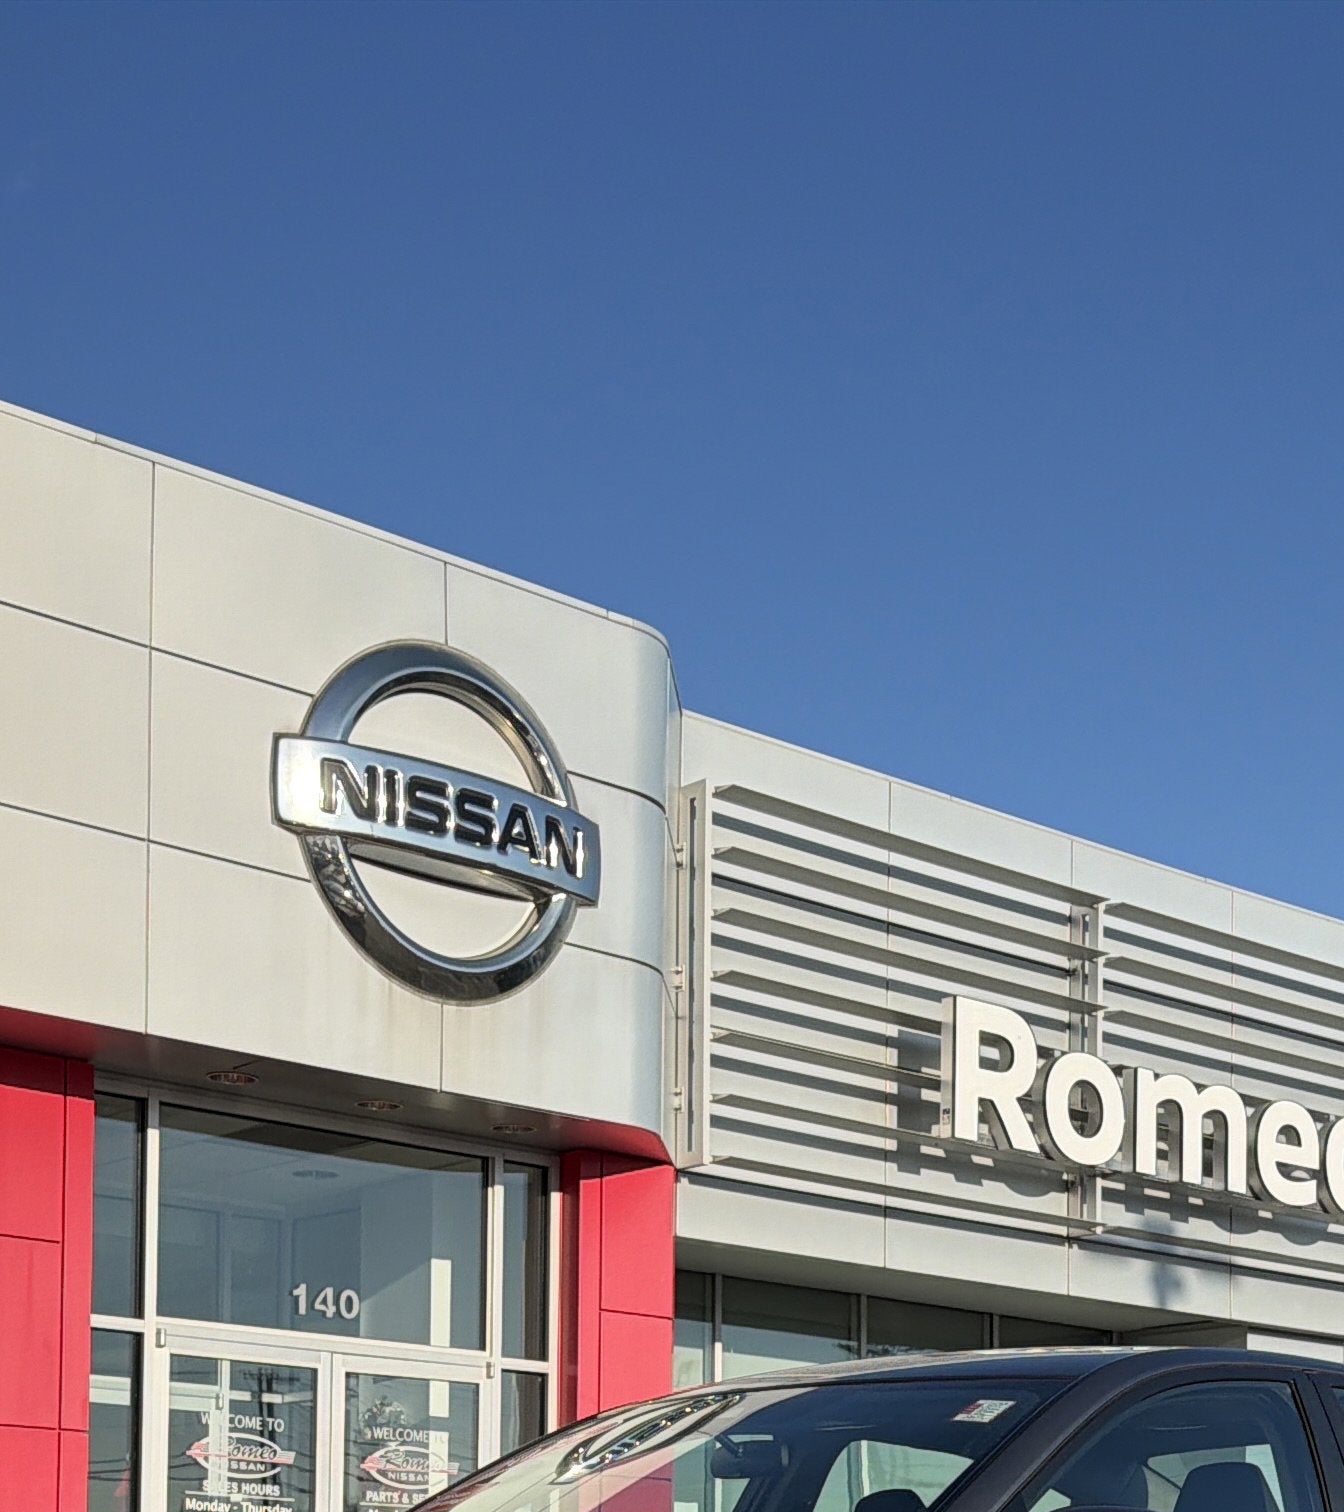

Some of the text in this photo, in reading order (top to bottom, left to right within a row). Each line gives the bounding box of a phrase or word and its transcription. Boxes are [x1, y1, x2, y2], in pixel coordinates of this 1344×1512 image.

[318, 756, 585, 879] NISSAN
[292, 1282, 360, 1320] 140
[265, 1417, 285, 1433] TO
[372, 1426, 430, 1442] WELCOME
[241, 1482, 281, 1497] HOURS
[365, 1490, 399, 1504] PARTS
[401, 1492, 410, 1504] &
